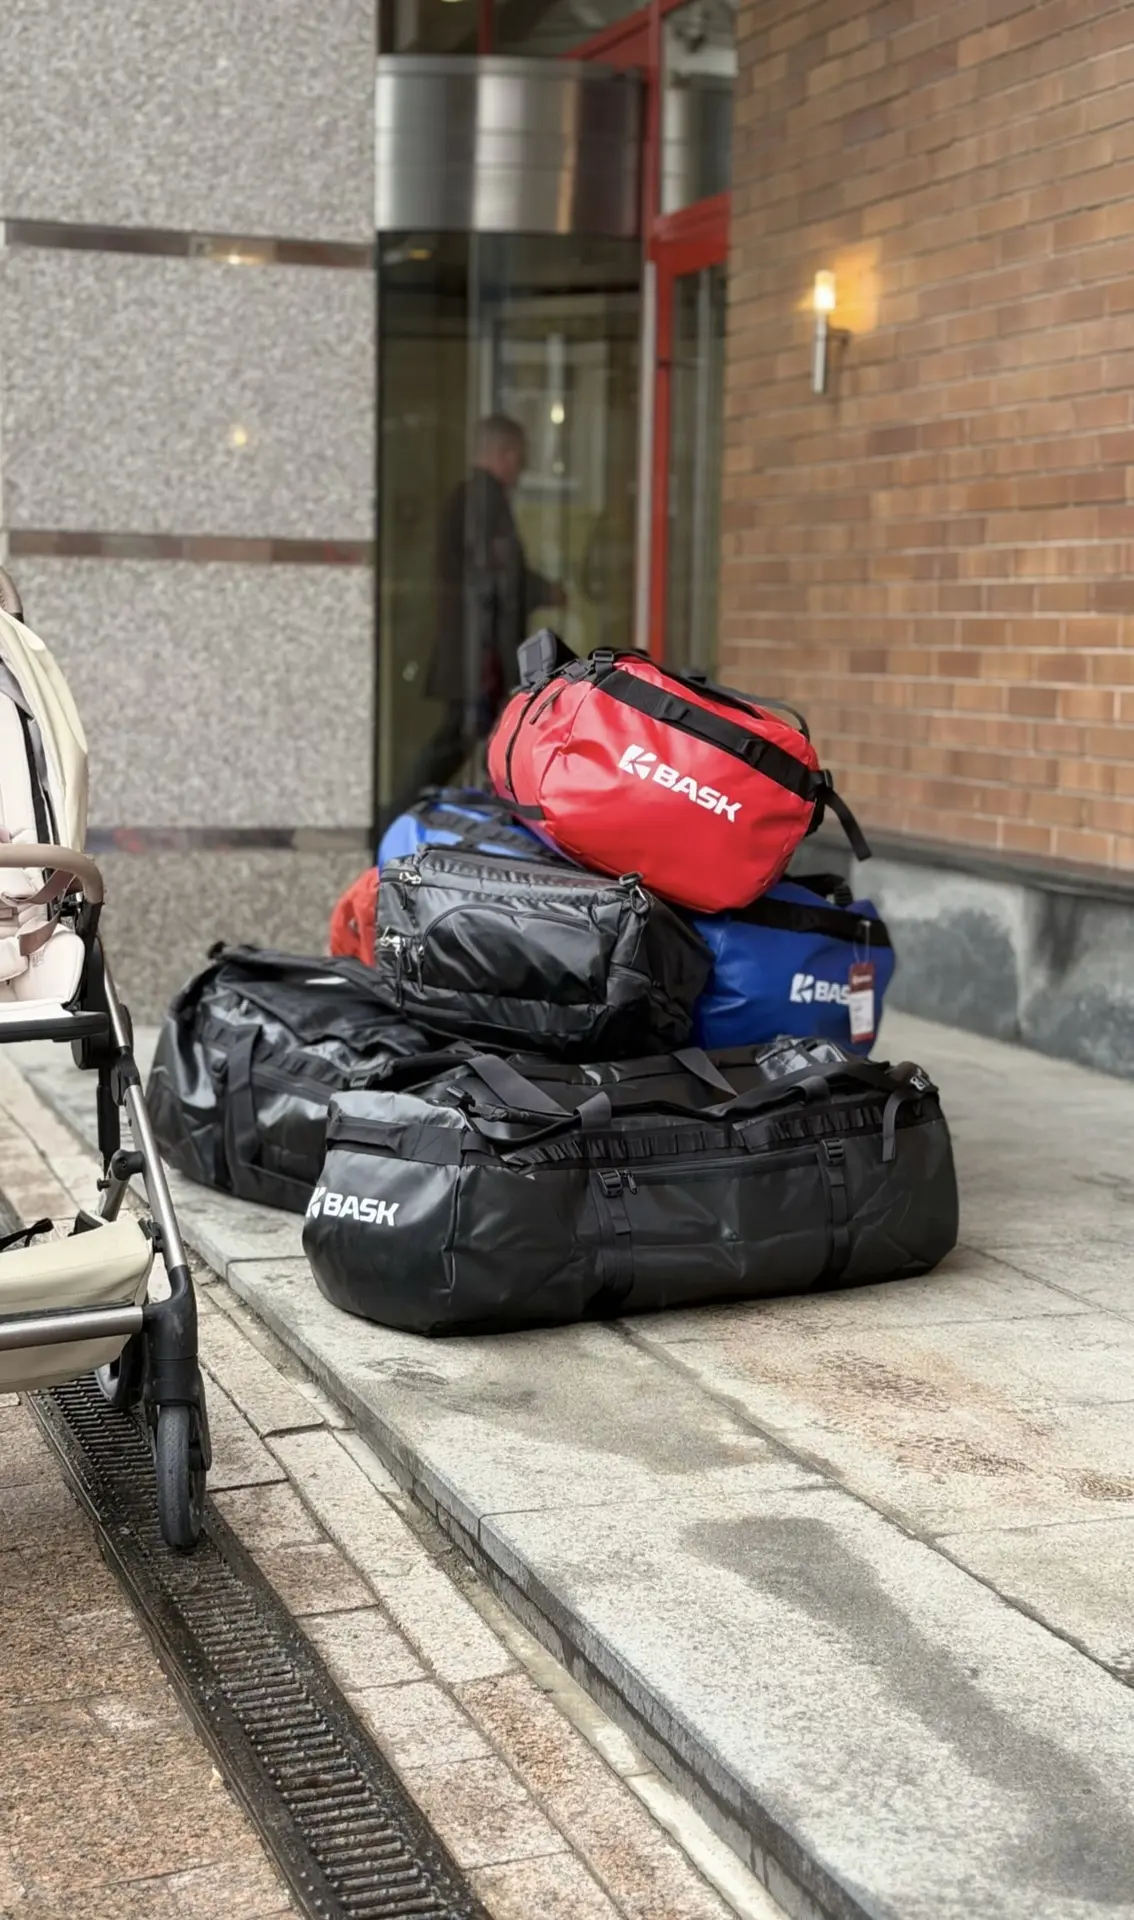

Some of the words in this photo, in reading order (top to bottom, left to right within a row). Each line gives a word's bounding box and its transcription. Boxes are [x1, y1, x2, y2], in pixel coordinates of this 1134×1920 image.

[652, 763, 742, 823] BASK
[814, 980, 851, 1005] BAS
[323, 1192, 399, 1227] BASK
